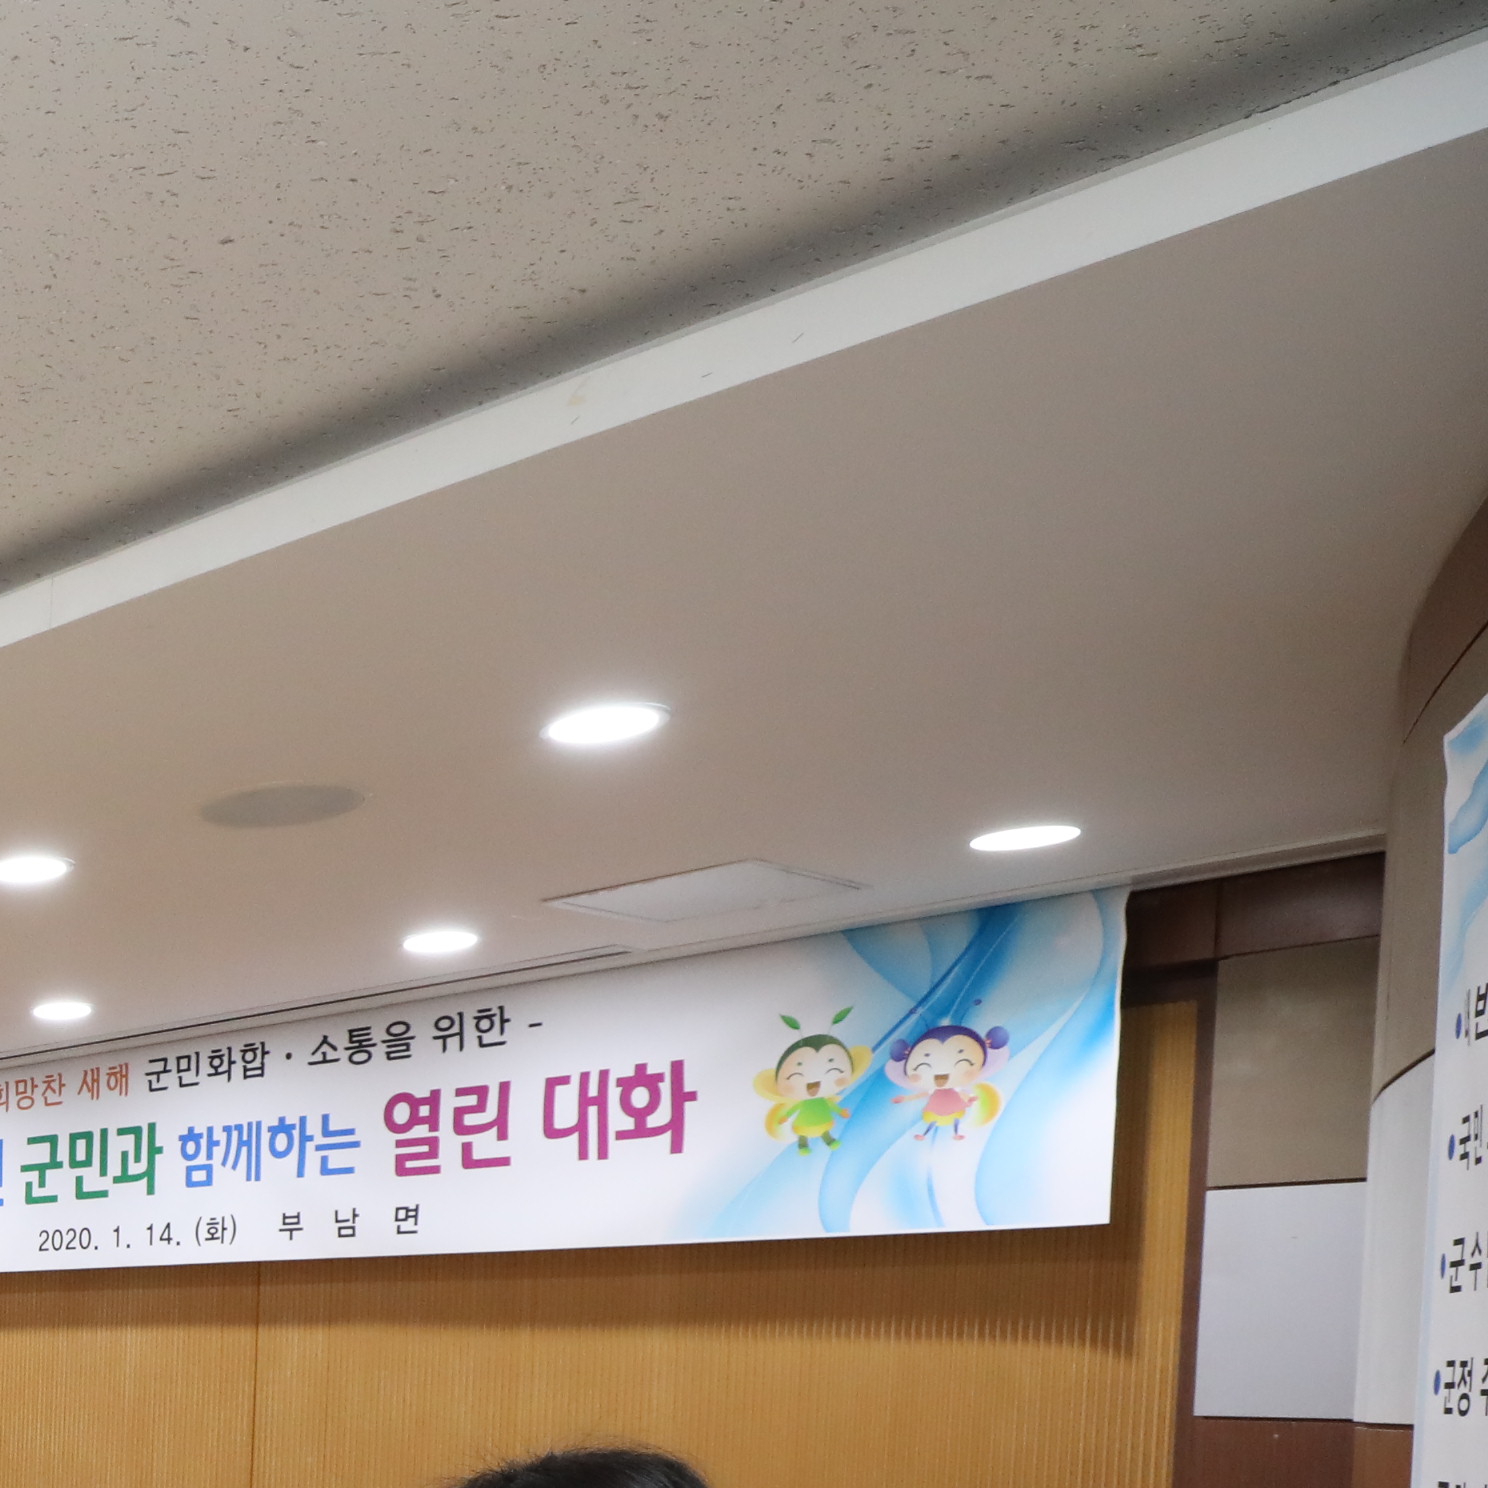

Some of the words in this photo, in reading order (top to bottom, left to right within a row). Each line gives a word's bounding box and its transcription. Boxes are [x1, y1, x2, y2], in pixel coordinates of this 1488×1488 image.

[77, 1062, 130, 1100] 새해
[144, 1041, 270, 1093] 군민화합
[306, 1020, 416, 1066] 소통을
[432, 1005, 512, 1053] 위한
[20, 1122, 164, 1206] 군민과
[178, 1113, 361, 1189] 함께하는
[383, 1080, 512, 1177] 열린
[542, 1059, 698, 1161] 대화
[1459, 1104, 1488, 1171] 국민
[38, 1227, 99, 1252] 2020.
[112, 1225, 131, 1250] 1.
[146, 1221, 182, 1247] 14.
[194, 1213, 237, 1248] (화)
[1449, 1231, 1488, 1293] 군수
[1444, 1357, 1474, 1417] 군정
